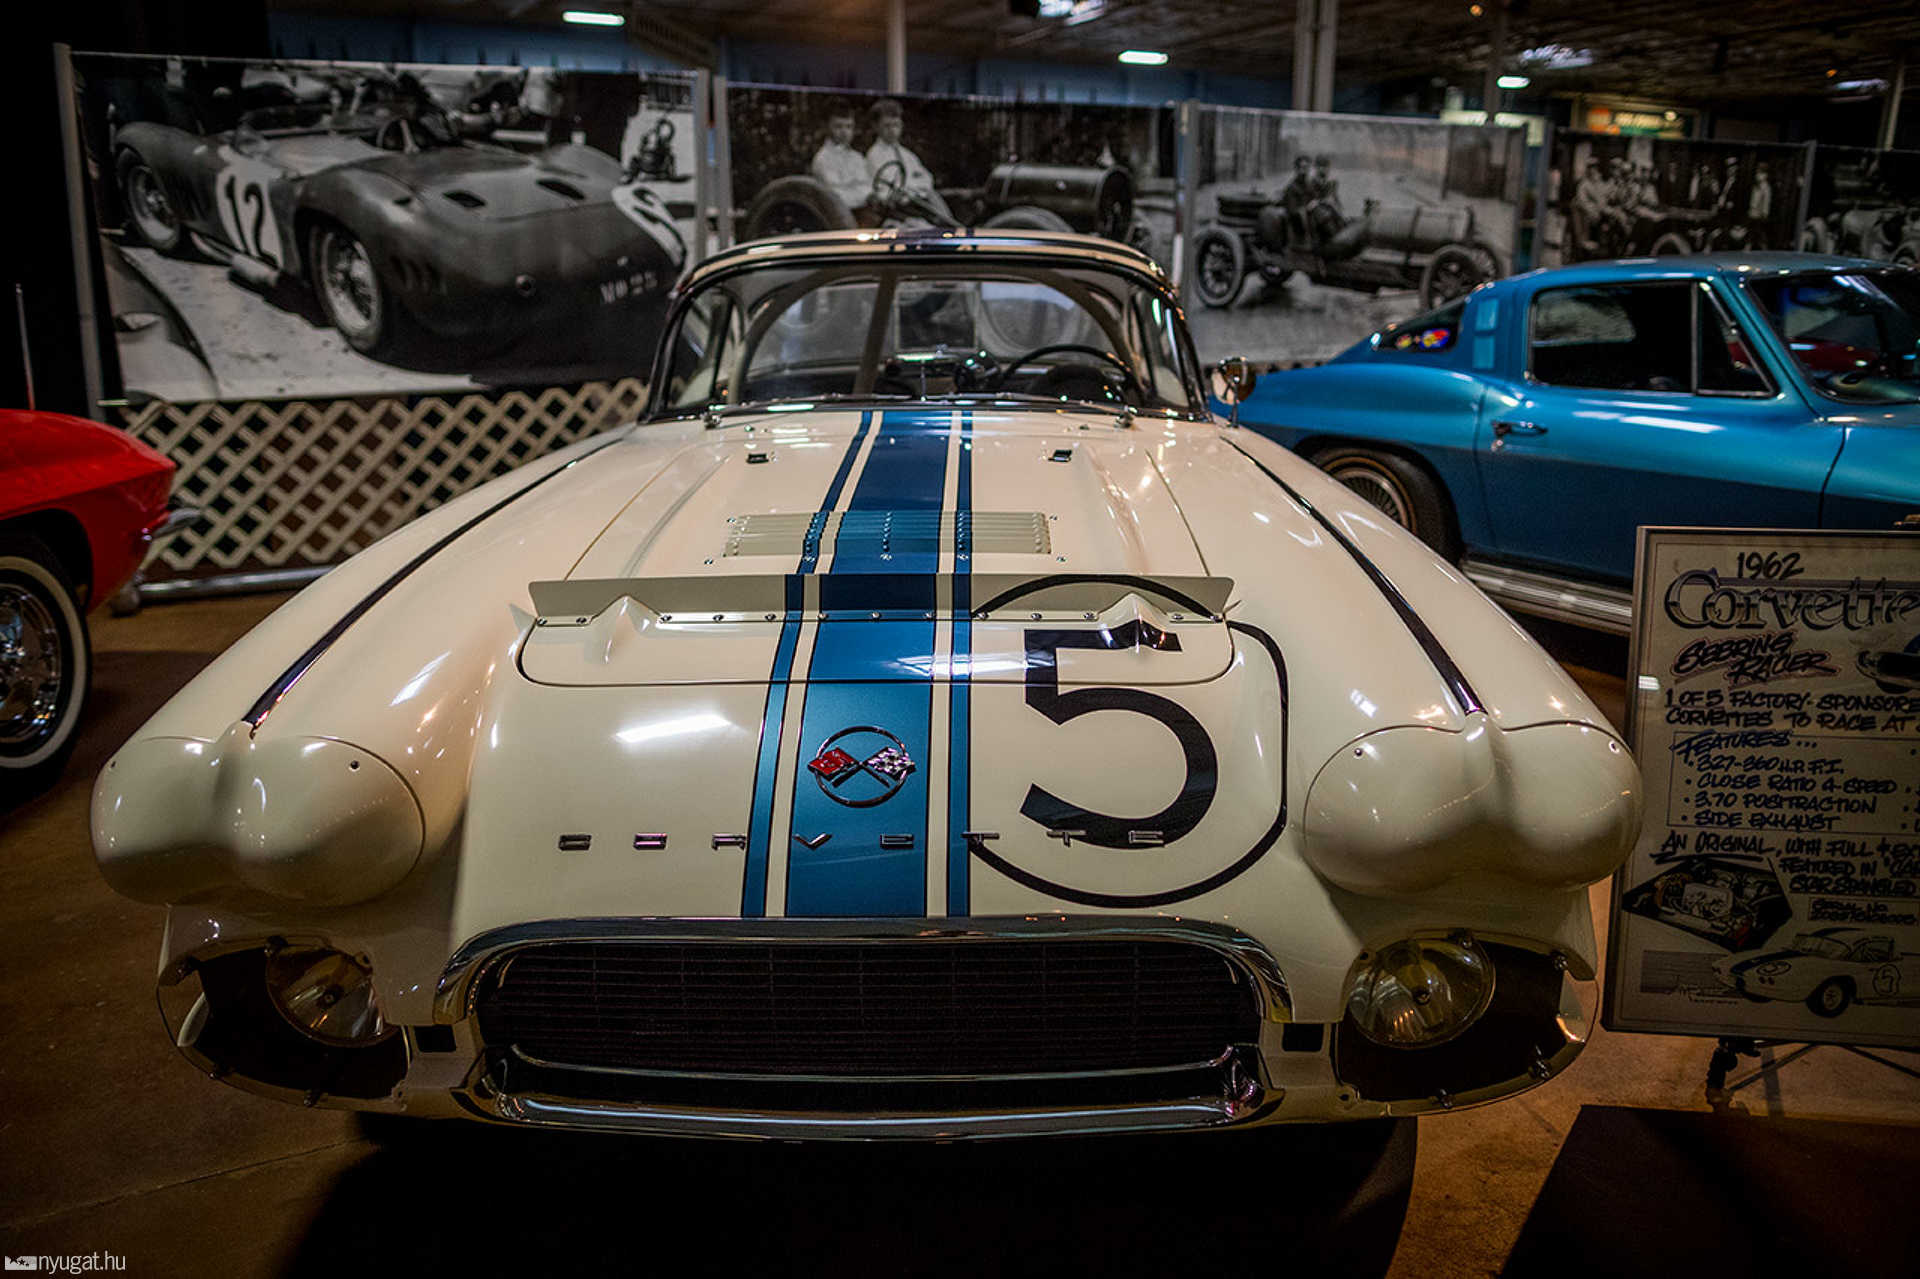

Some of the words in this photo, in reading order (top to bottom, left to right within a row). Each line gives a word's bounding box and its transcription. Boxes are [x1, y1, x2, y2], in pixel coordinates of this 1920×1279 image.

[1738, 551, 1804, 581] 1962
[1664, 567, 1920, 630] Corvette
[1674, 631, 1793, 673] SEBRING
[1727, 651, 1838, 683] RACER
[1678, 691, 1704, 706] OF
[1706, 690, 1724, 707] 5
[1666, 708, 1772, 727] CORVETTES
[1783, 712, 1811, 729] TO
[1816, 713, 1876, 731] RACE
[1881, 714, 1916, 733] AT
[1020, 619, 1218, 850] 5
[1697, 772, 1761, 789] CLOSE
[1768, 775, 1817, 792] RATIO
[1743, 793, 1877, 813] POSITRACTION
[1694, 809, 1742, 827] SIDE
[1750, 812, 1841, 833] EXHAUST
[558, 831, 1165, 851] CORVETTE
[1660, 829, 1688, 854] AN
[1785, 837, 1822, 857] WITH
[1825, 840, 1876, 857] FULL
[1778, 856, 1857, 876] FEATURED
[1860, 860, 1878, 876] IN
